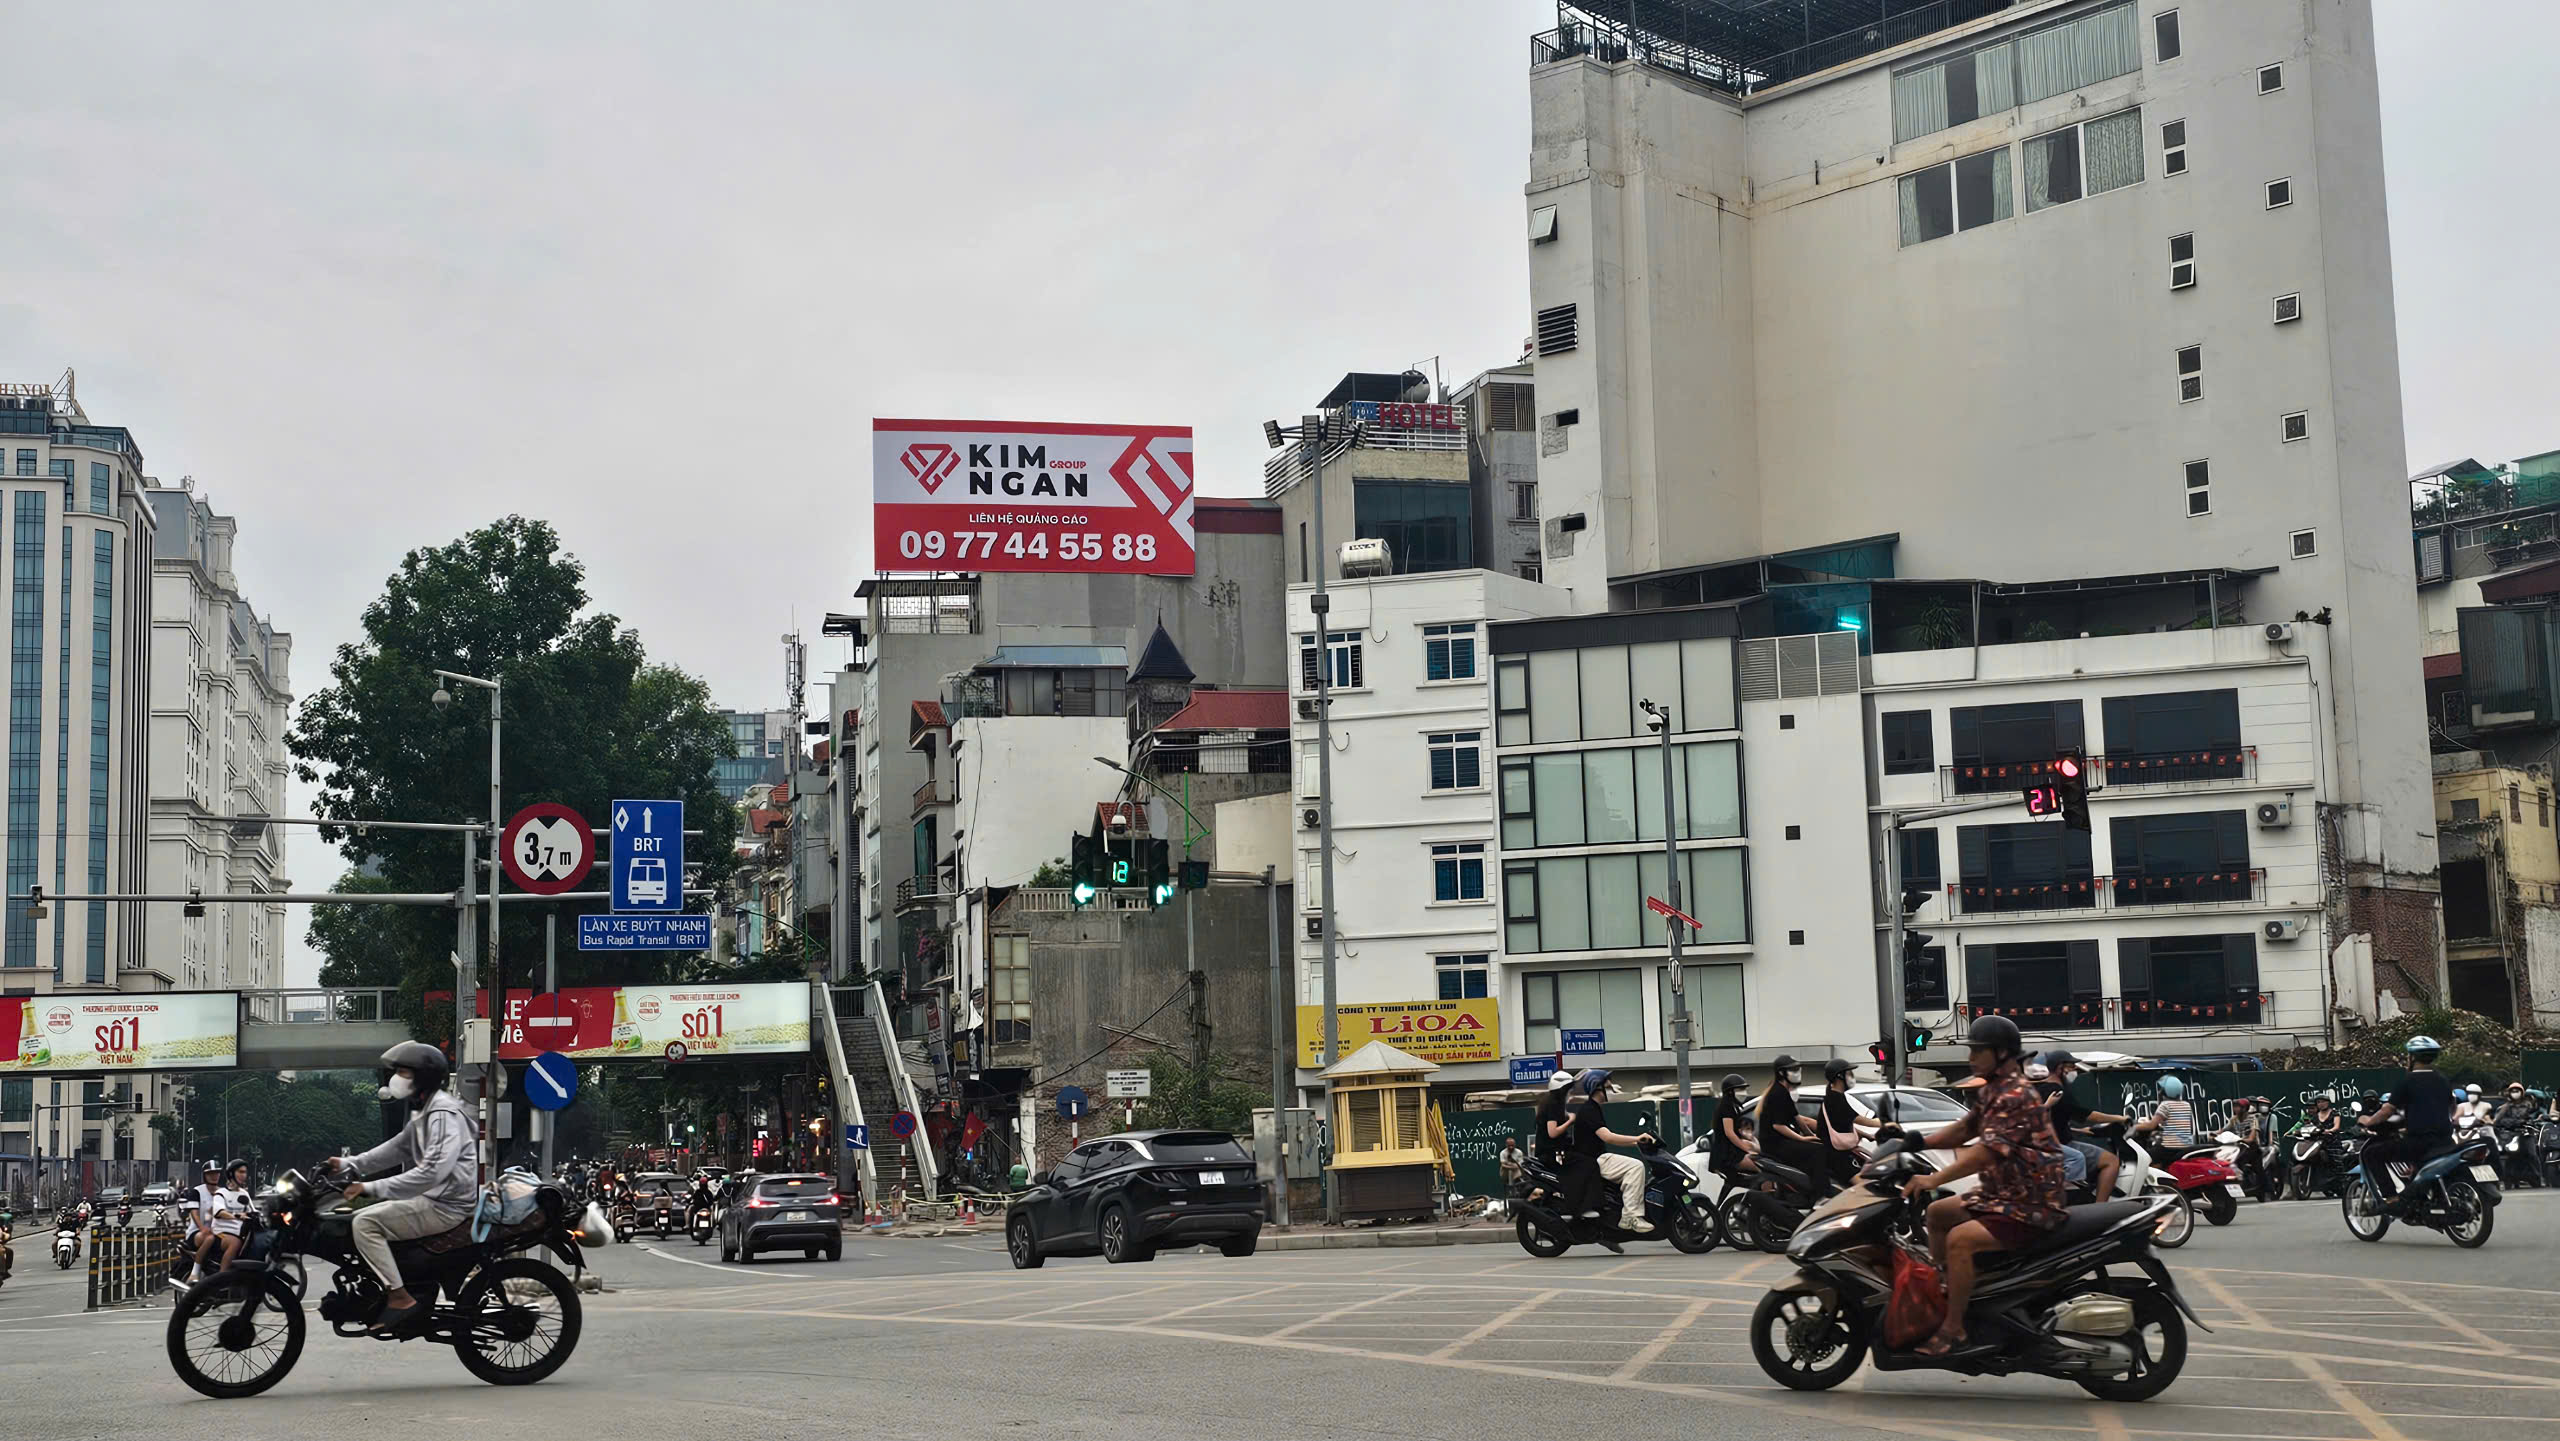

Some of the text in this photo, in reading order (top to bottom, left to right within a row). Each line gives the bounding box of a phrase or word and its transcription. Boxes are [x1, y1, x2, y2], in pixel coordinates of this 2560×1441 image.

[1379, 402, 1461, 429] HOTEL
[969, 444, 1087, 469] KIM GROUP
[969, 471, 1088, 497] NGAN
[969, 511, 1088, 526] LIÊN HỆ QUẢNG CÁO
[900, 530, 946, 560] 09
[1058, 533, 1103, 561] 55
[1111, 533, 1157, 562] 88
[2030, 788, 2057, 813] 21
[524, 832, 572, 870] 3,7 m
[633, 837, 663, 852] BRT
[1112, 861, 1129, 882] 12
[584, 917, 706, 932] LÀN XE BUÝT NHANH
[584, 934, 706, 947] Bus Rapid Transit (BRT)
[682, 1005, 722, 1039] SỐ 1
[1369, 1013, 1486, 1034] LiOA
[95, 1017, 139, 1053] SỐ 1
[1566, 1042, 1577, 1051] LA
[101, 1055, 133, 1065] VIỆT NAM
